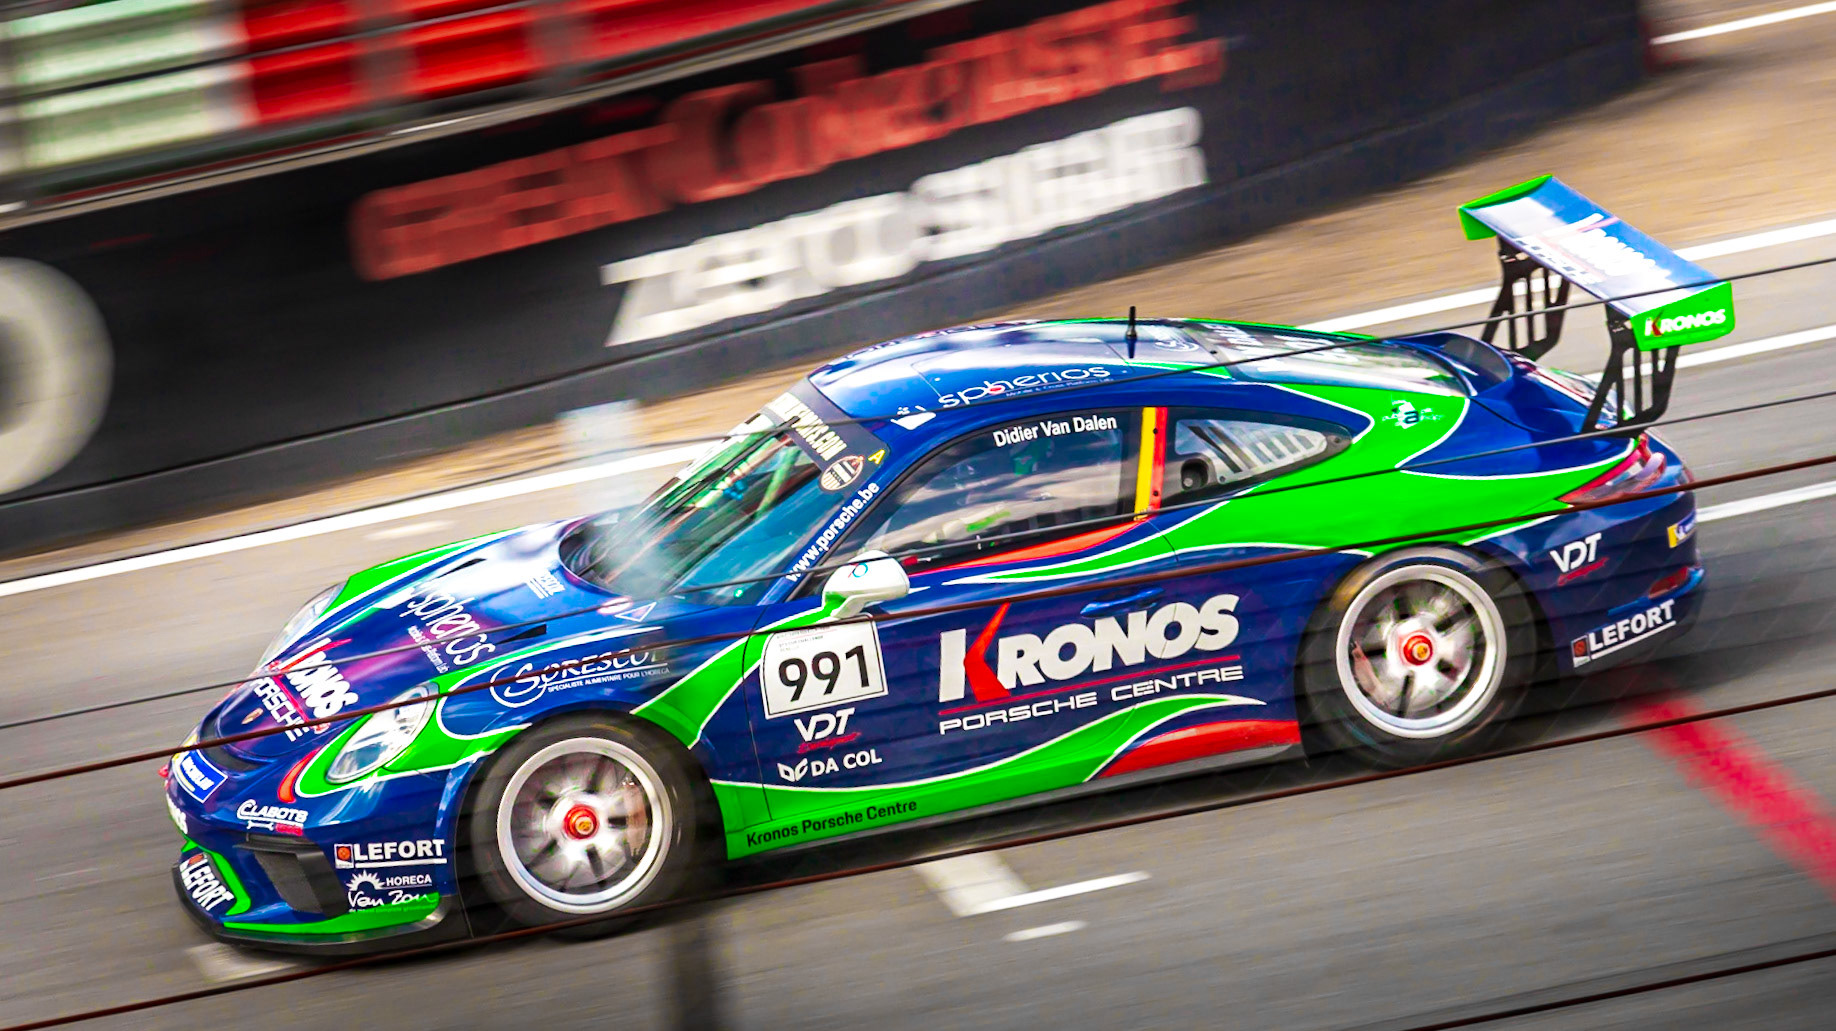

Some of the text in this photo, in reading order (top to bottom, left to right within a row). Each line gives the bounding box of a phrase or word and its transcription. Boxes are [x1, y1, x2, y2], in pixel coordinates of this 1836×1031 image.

[1645, 309, 1726, 337] KRONOS
[938, 365, 1110, 409] spherios
[993, 414, 1118, 447] Didier Van Dalen
[868, 449, 886, 465] A
[785, 482, 880, 582] www.porsche.be
[1550, 532, 1602, 573] VDT
[1588, 599, 1675, 652] LEFORT
[938, 593, 1240, 703] KRONOS
[623, 671, 640, 679] POUR
[778, 645, 870, 702] 991
[939, 665, 1244, 735] PORSCHE CENTRE
[794, 707, 856, 742] VDT
[810, 757, 839, 777] DA
[842, 748, 883, 770] COL
[237, 799, 308, 823] CLABOTS
[746, 799, 917, 848] Kronos Porsche Centre
[353, 839, 445, 860] LEFORT
[182, 858, 235, 912] LEFORT
[386, 874, 432, 886] HORECA
[348, 890, 384, 908] Van
